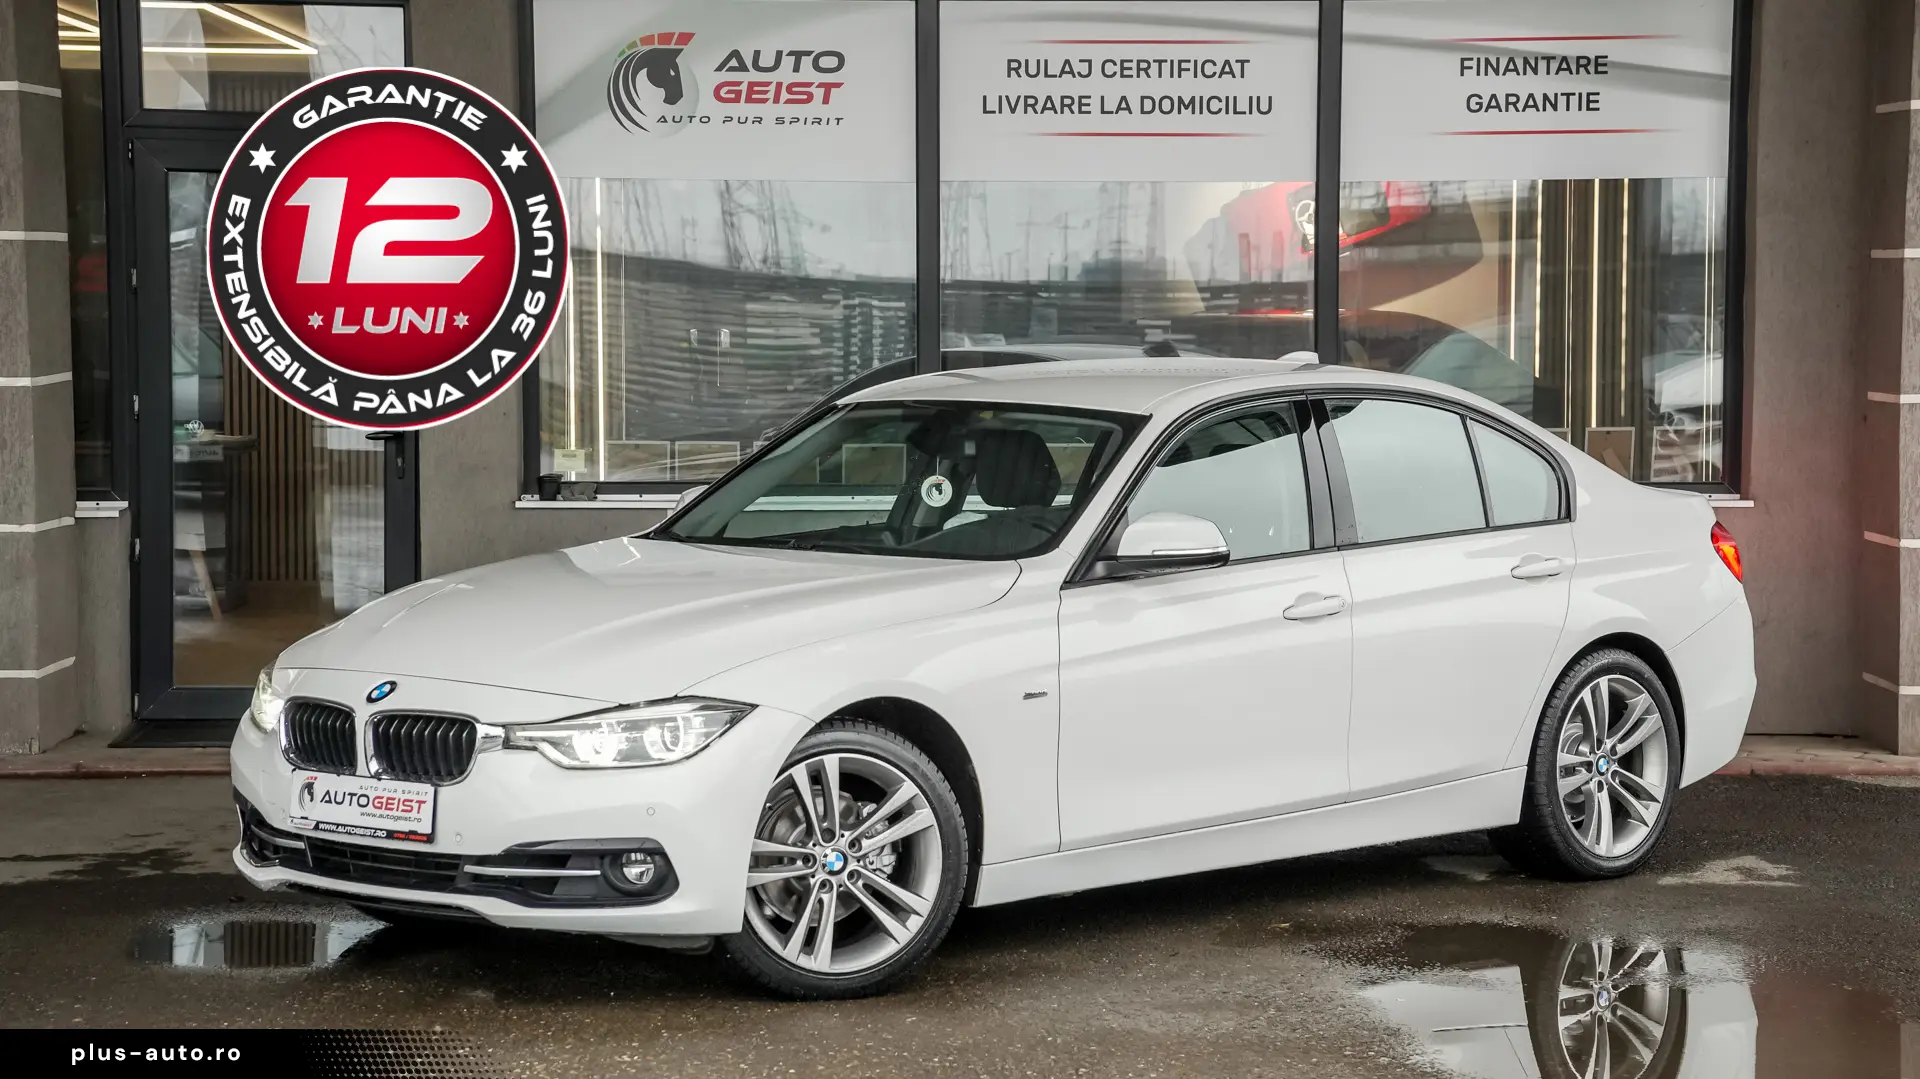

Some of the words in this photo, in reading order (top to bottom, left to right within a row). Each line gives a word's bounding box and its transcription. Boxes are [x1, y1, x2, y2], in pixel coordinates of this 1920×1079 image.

[713, 48, 846, 74] AUTO
[1006, 58, 1093, 79] RULAJ
[1100, 58, 1250, 79] CERTIFICAT
[1459, 55, 1609, 77] FINANTARE
[713, 81, 845, 105] GEIST
[1465, 92, 1601, 114] GARANTIE
[982, 94, 1092, 115] LIVRARE
[1099, 94, 1133, 115] LA
[1140, 95, 1273, 116] DOMICILIU
[656, 115, 711, 124] AUTO
[722, 116, 763, 125] PUR
[775, 116, 845, 126] SPIRIT
[360, 811, 422, 823] www.autogeist.ro
[318, 822, 387, 838] WWW.AUTOGEIST.RO
